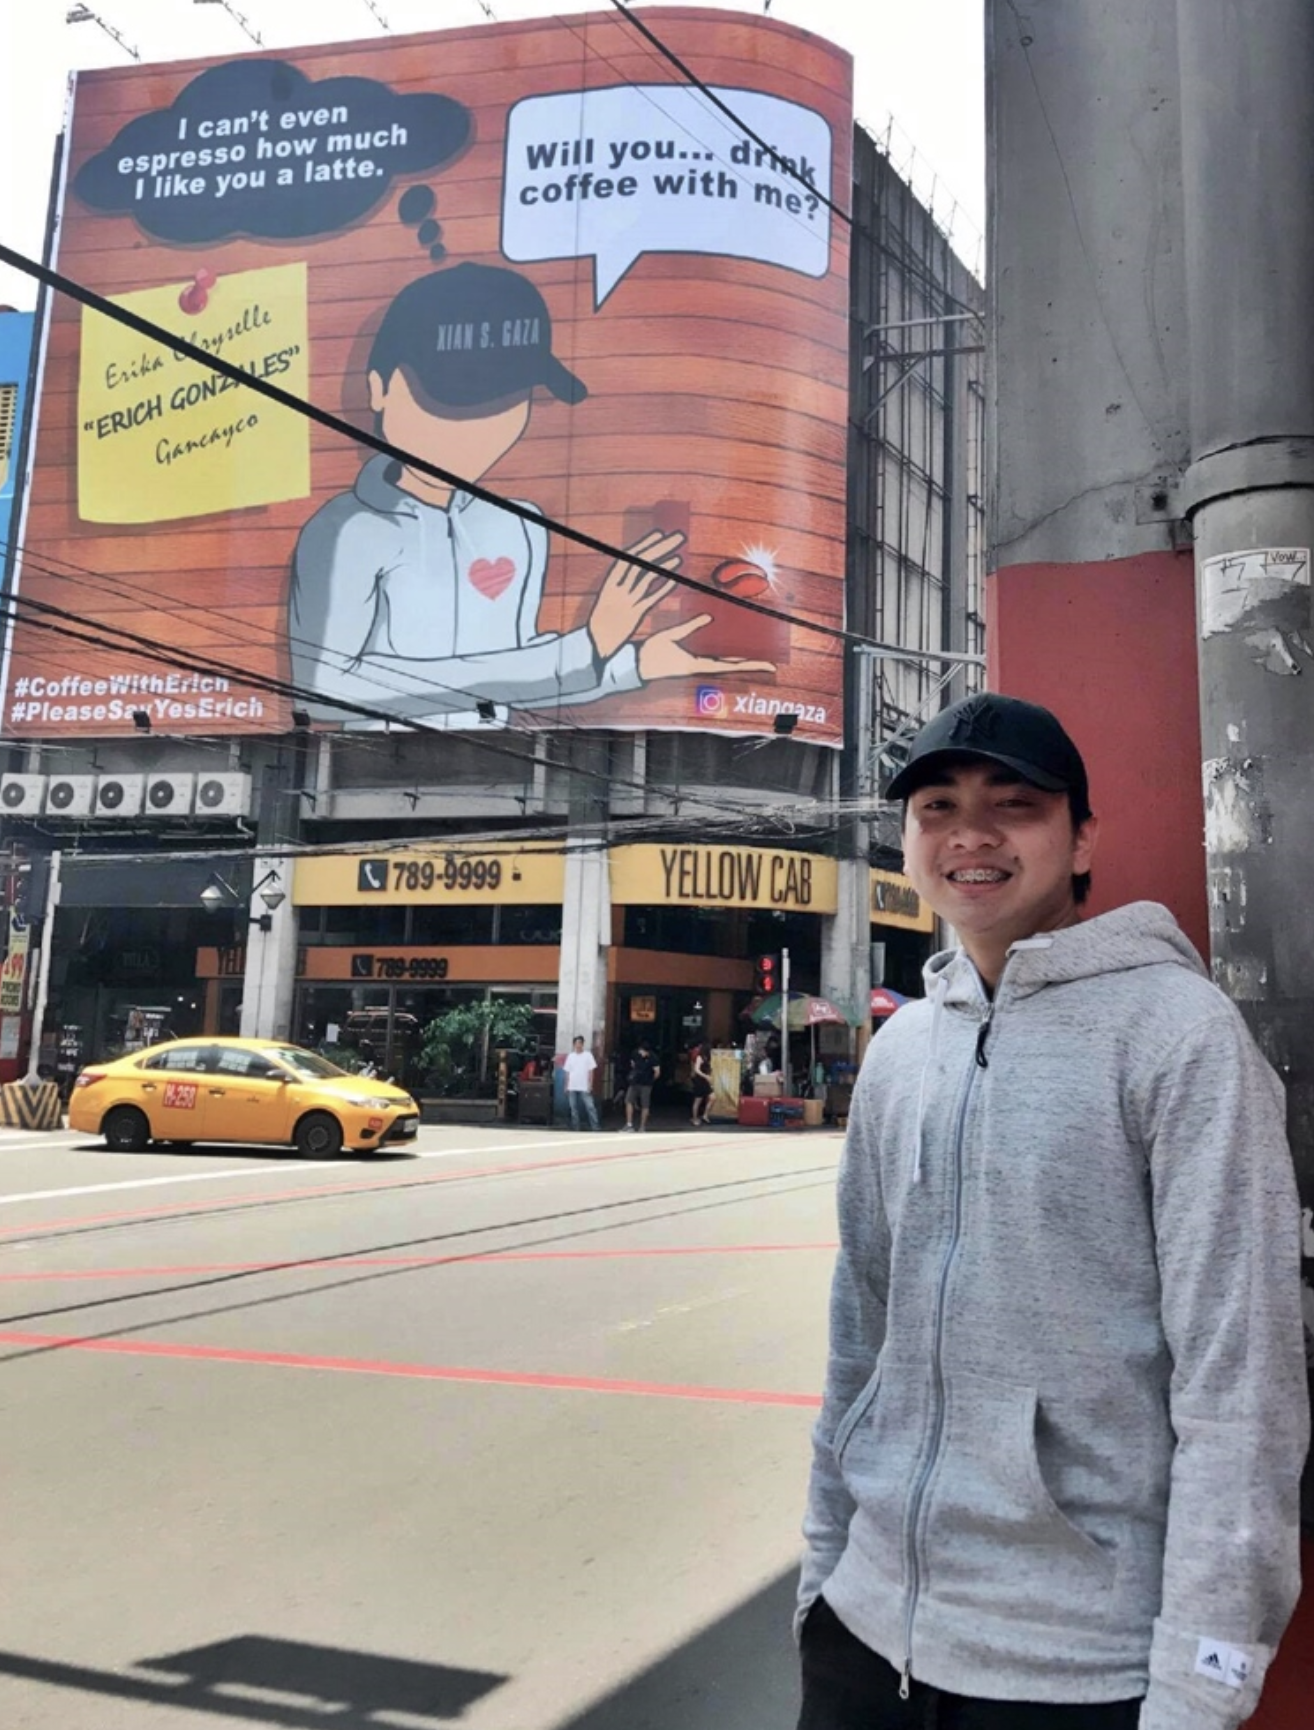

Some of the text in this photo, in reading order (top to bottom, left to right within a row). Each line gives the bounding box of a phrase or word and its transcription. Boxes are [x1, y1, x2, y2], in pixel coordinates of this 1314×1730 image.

[178, 106, 348, 139] I can't even
[118, 123, 408, 177] espresso how much
[526, 138, 816, 187] Will you... drink
[135, 157, 384, 199] I like you a latte.
[519, 169, 819, 220] coffee with me?
[436, 317, 540, 352] XIAN S. GAZA
[83, 344, 300, 440] "ERICH GONZLES"
[105, 353, 164, 390] Erika
[155, 414, 259, 466] Gancayco
[14, 673, 229, 698] #CoffeeWithErich
[393, 859, 502, 891] 789-9999
[660, 848, 812, 905] YELLOW CAB
[376, 956, 449, 978] 789-9999
